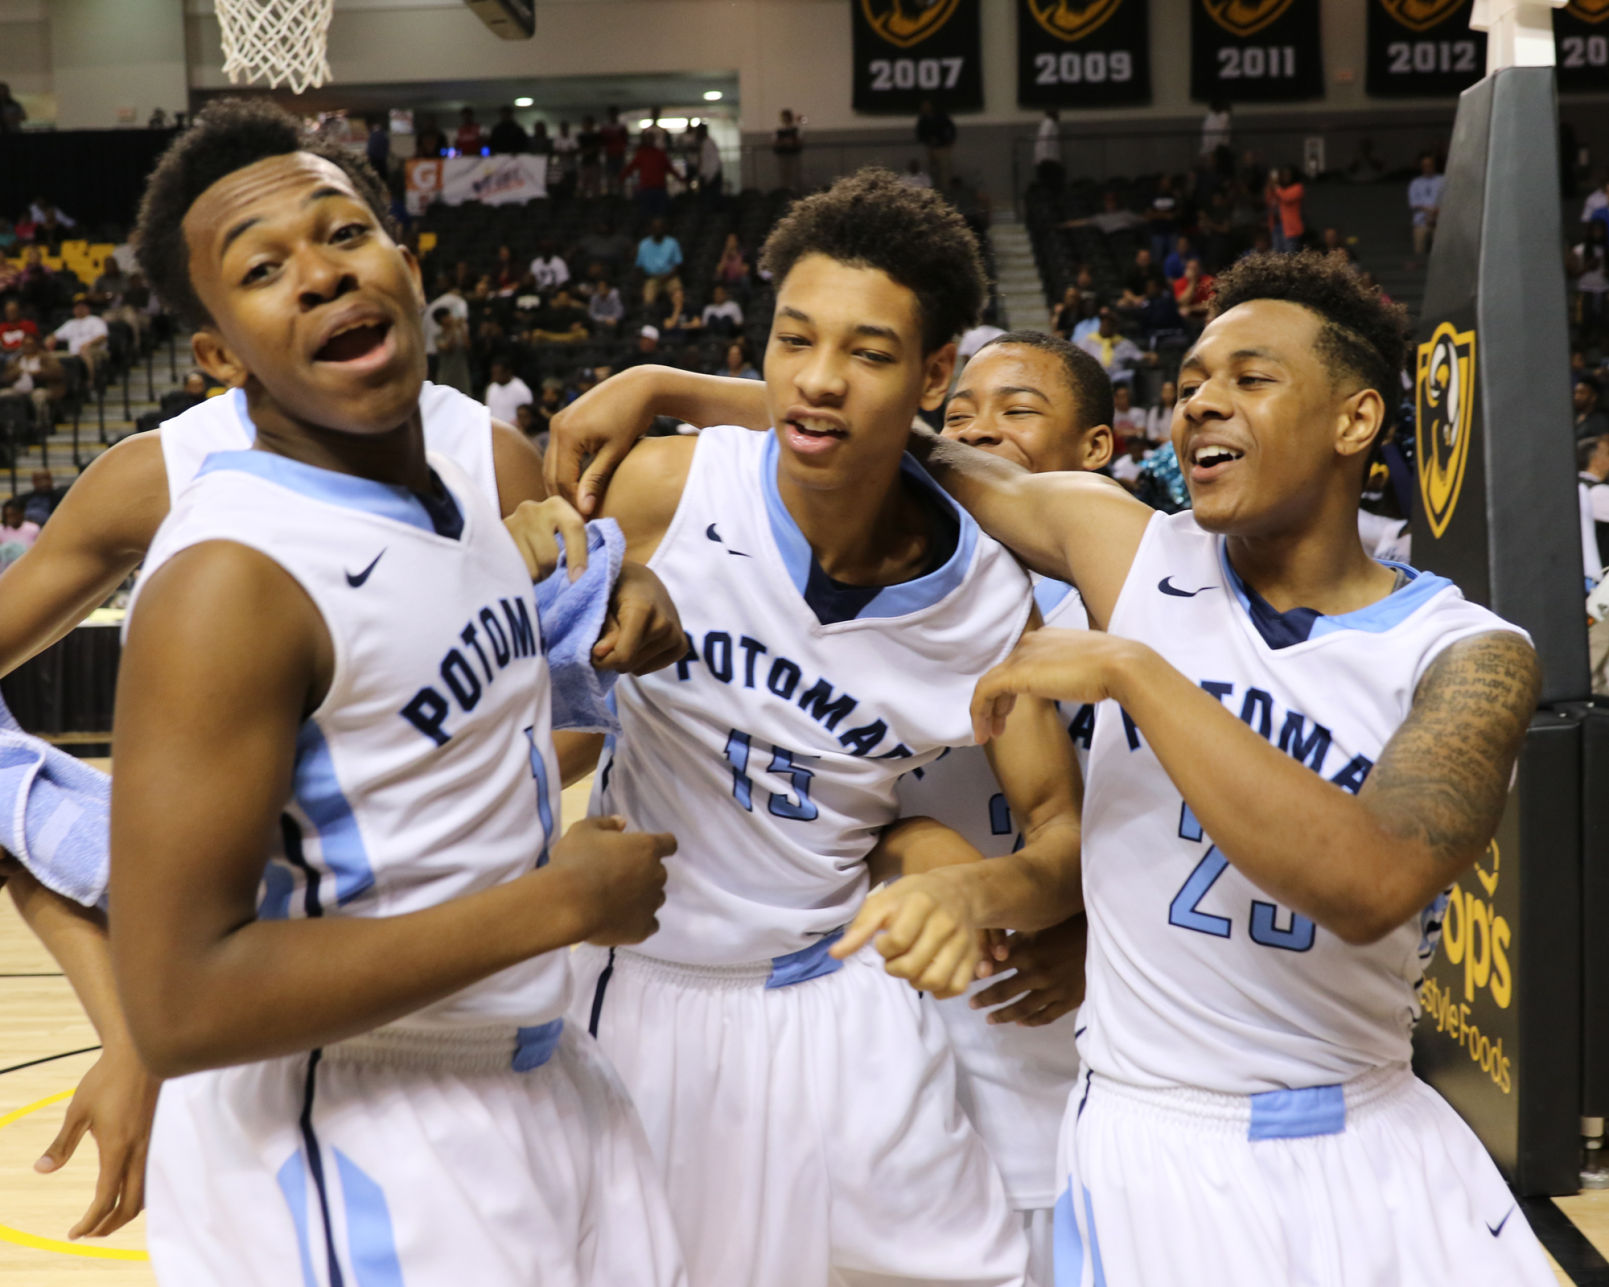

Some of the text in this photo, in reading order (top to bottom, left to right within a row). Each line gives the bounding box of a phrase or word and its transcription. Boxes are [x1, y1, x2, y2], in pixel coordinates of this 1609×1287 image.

[1034, 51, 1132, 85] 2009
[1217, 46, 1296, 79] 2011
[1387, 41, 1476, 73] 2012
[1562, 36, 1608, 67] 20
[869, 58, 964, 90] 2007
[399, 597, 546, 747] POTOM
[676, 629, 914, 760] POTOMA
[724, 728, 819, 822] 15
[1442, 882, 1512, 1009] op's
